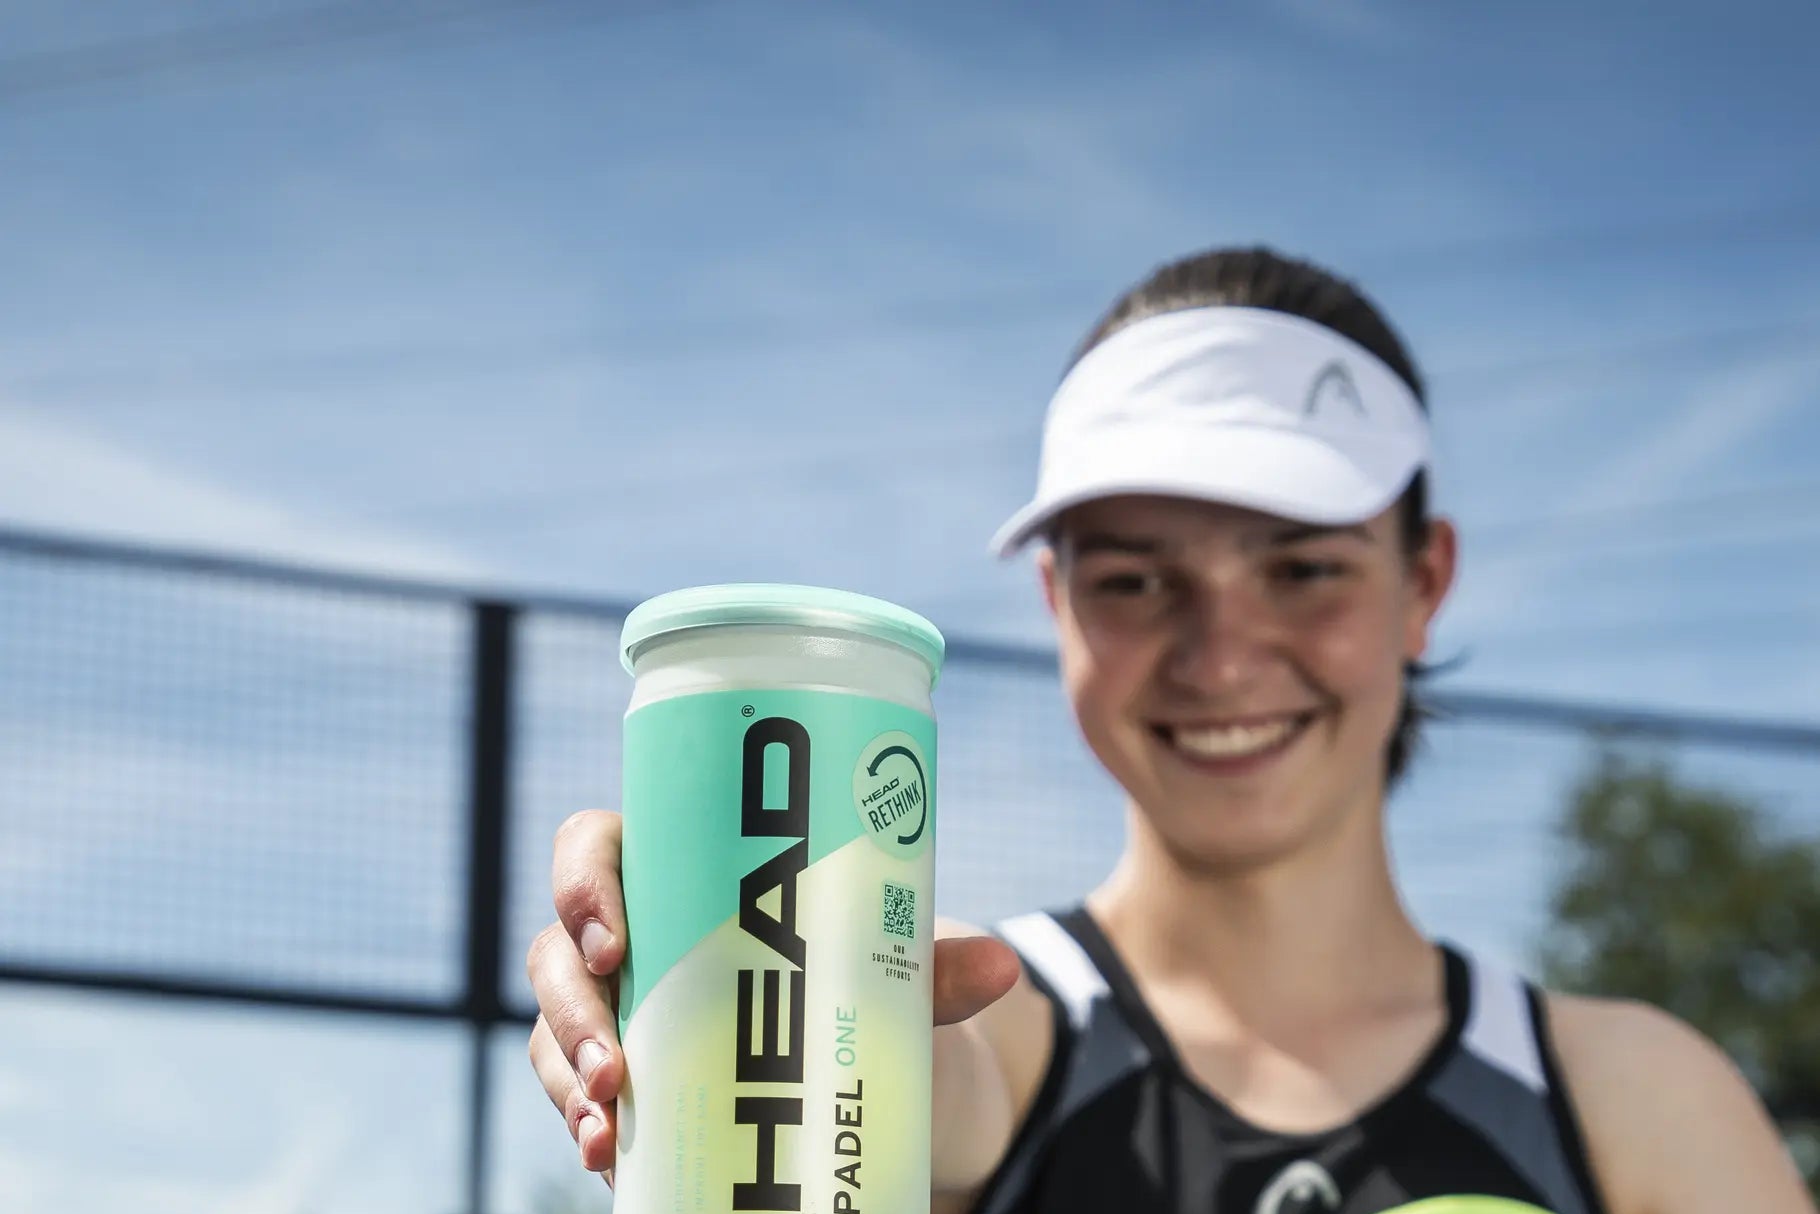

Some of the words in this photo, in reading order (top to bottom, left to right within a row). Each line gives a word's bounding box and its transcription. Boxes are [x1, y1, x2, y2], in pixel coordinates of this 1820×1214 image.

[867, 779, 922, 833] RETHINK
[885, 967, 911, 982] EFFORTS
[835, 1006, 857, 1067] ONE
